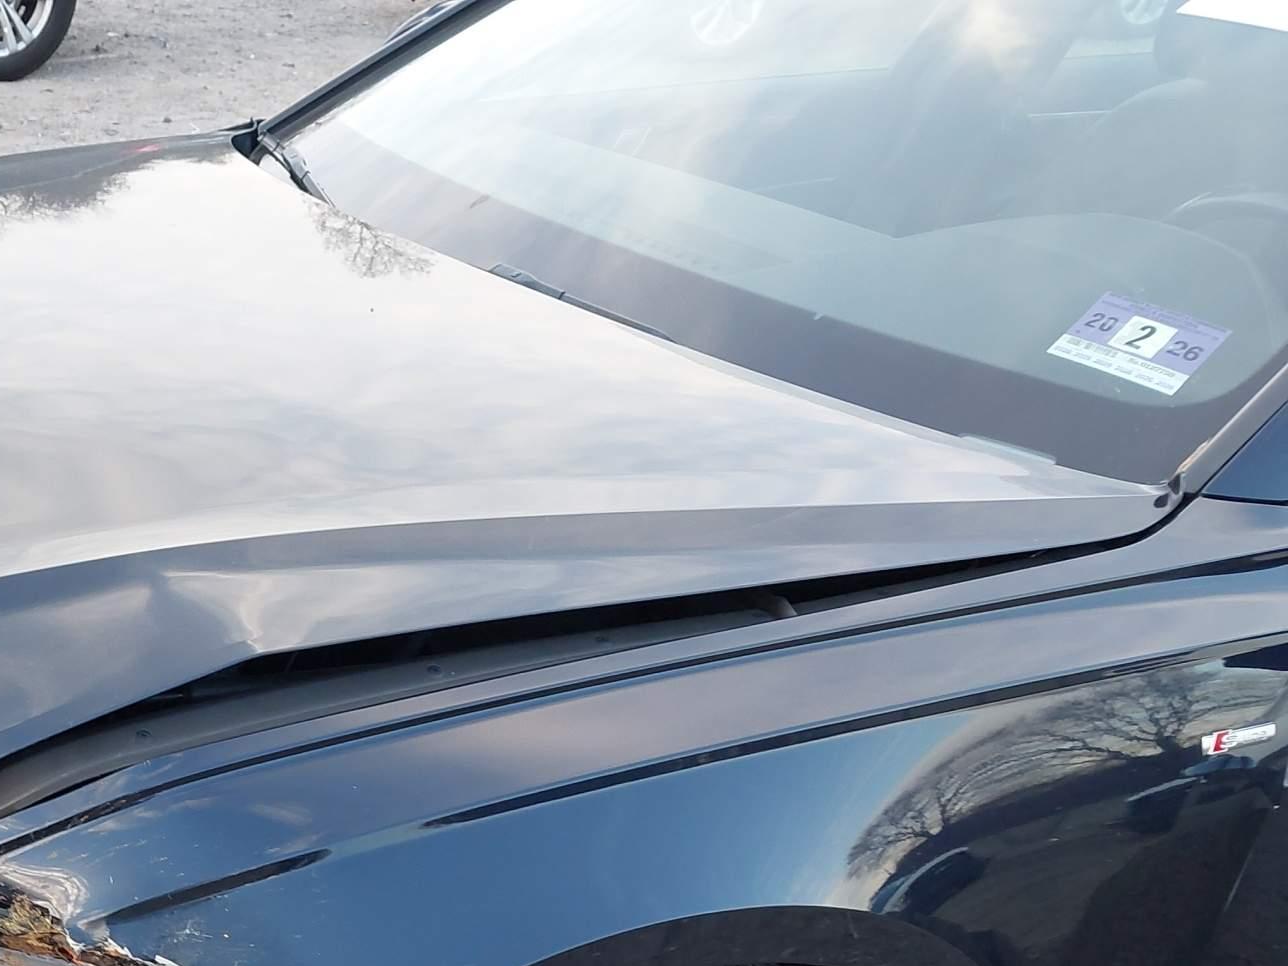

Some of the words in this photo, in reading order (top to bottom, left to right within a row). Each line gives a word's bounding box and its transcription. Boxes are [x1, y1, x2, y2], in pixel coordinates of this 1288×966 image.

[1084, 311, 1119, 332] 20
[1124, 324, 1158, 350] 2
[1166, 339, 1205, 362] 26
